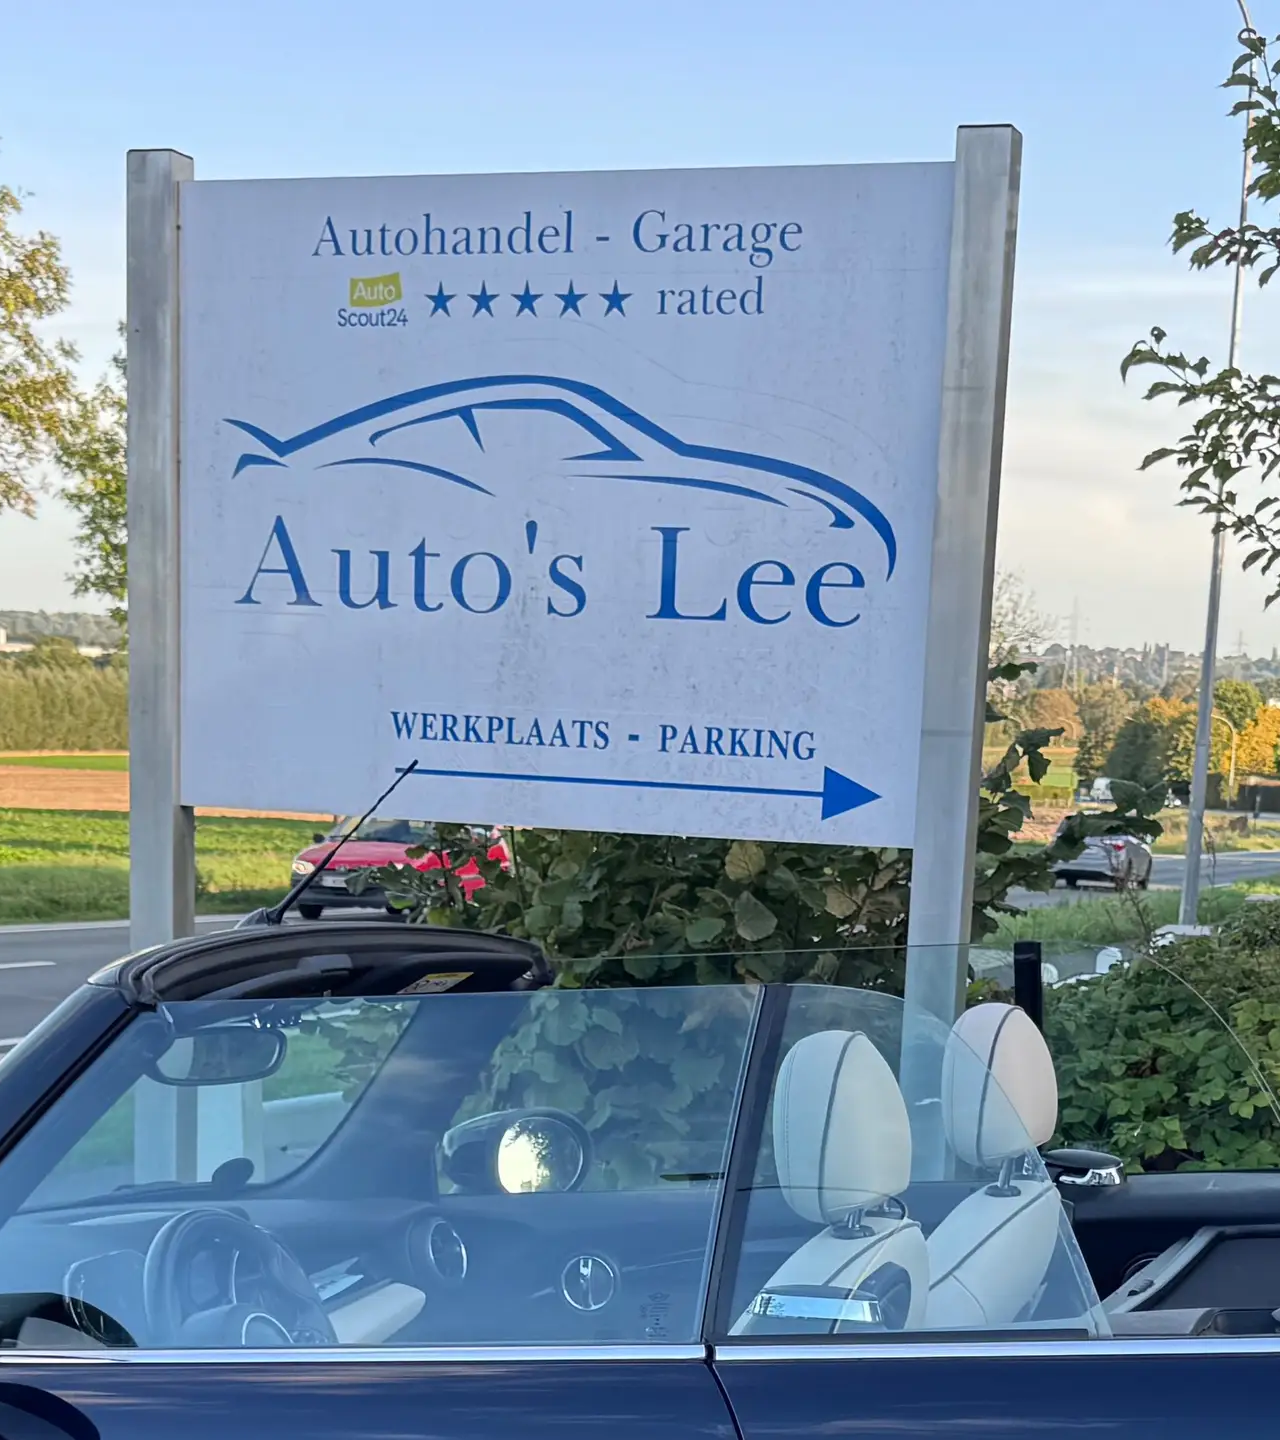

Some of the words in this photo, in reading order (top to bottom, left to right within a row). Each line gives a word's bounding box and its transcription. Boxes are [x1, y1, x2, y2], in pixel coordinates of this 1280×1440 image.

[311, 211, 574, 257] Autohandel
[632, 209, 804, 268] Garage
[353, 281, 396, 301] Auto
[656, 275, 765, 317] rated
[337, 308, 409, 327] Scout24
[234, 514, 588, 618] Auto's
[646, 525, 866, 629] Lee
[390, 710, 611, 751] WERKPLAATS
[658, 724, 818, 762] PARKING
